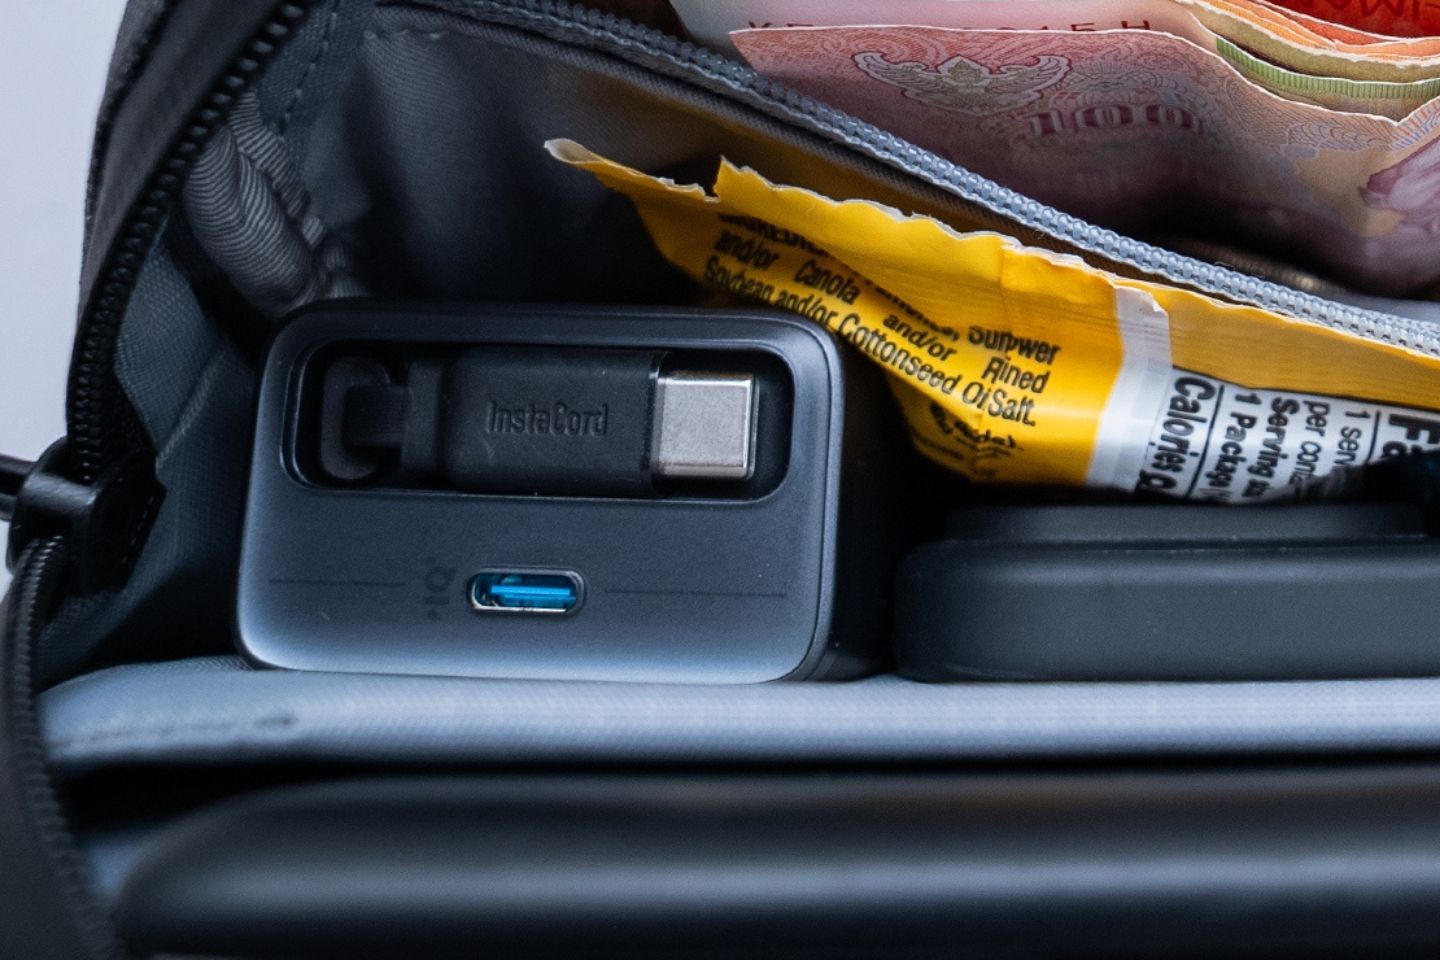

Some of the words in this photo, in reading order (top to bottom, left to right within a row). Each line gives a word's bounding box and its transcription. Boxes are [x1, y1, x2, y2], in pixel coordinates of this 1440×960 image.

[713, 230, 779, 270] and/or
[794, 258, 861, 305] Canola
[775, 289, 839, 330] and/or
[837, 312, 963, 396] Cottonseed
[882, 313, 959, 361] and/or
[485, 399, 610, 438] InstaCord
[987, 388, 1036, 427] Salt.
[1151, 375, 1217, 473] Calories
[1247, 396, 1300, 479] Serving
[1301, 399, 1330, 438] per
[1206, 411, 1257, 489] Package
[1333, 425, 1363, 468] serv
